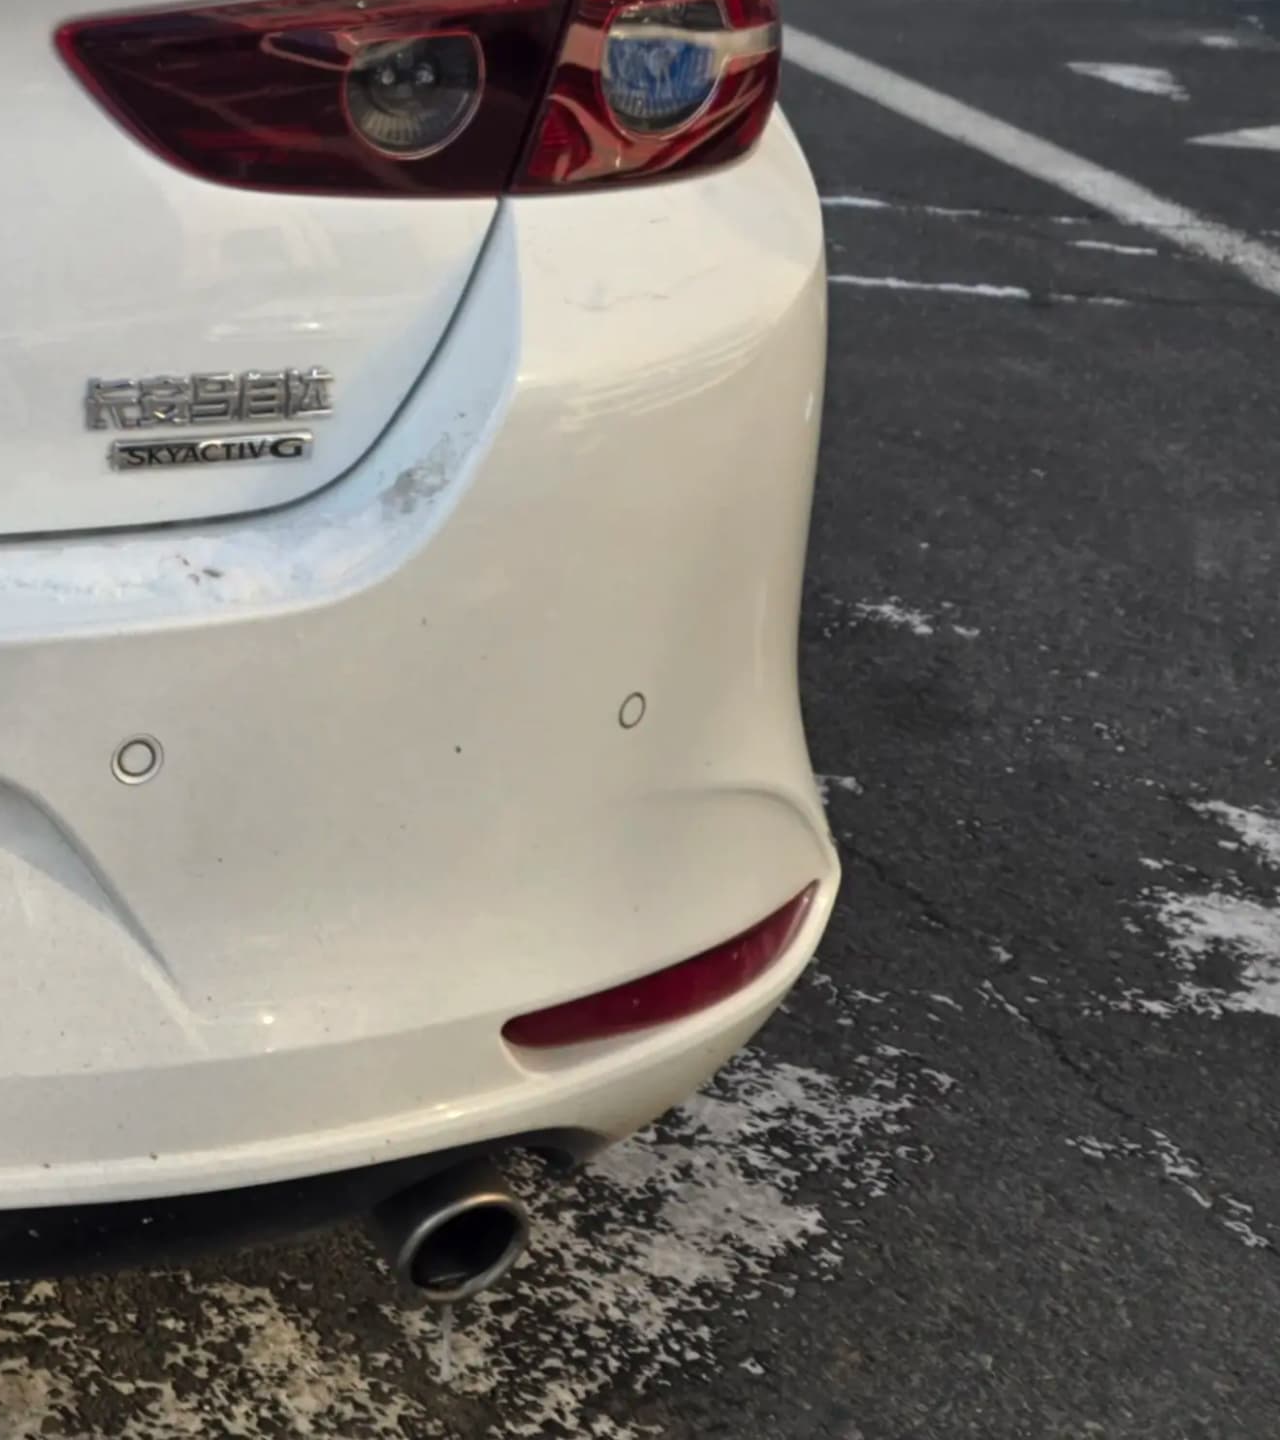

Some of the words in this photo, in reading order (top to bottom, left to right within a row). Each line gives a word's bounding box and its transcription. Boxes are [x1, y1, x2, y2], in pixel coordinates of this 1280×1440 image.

[85, 365, 336, 432] 长安马自达
